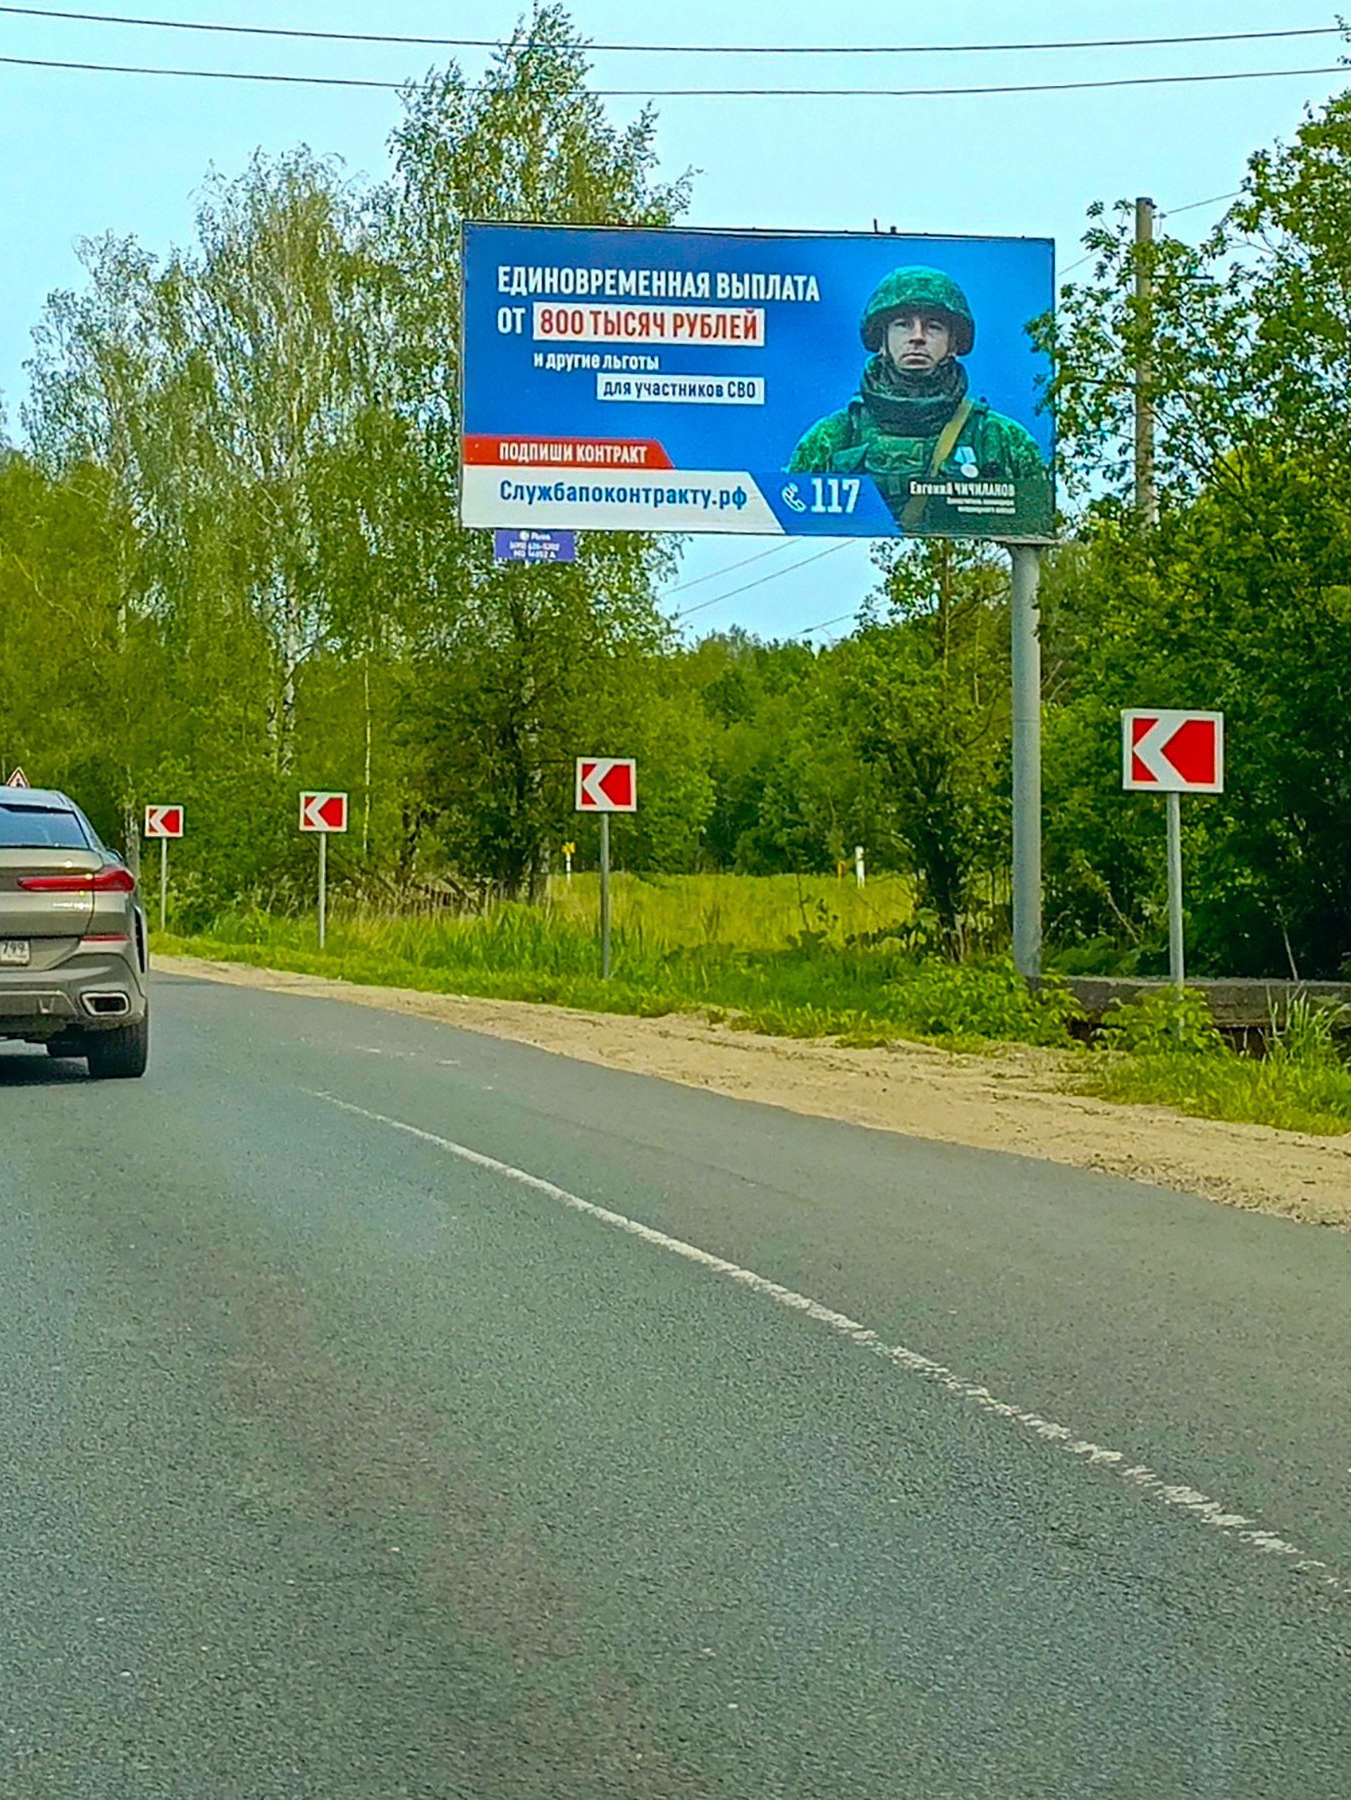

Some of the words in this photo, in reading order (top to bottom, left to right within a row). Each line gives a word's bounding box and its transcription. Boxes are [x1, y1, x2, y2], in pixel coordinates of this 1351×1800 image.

[498, 265, 710, 298] ЕДИНОВРЕМЕННАЯ
[716, 272, 820, 301] ВЫПЛАТА
[497, 306, 525, 334] ОТ
[541, 308, 584, 335] 800
[589, 310, 665, 337] ТЫСЯЧ
[672, 307, 757, 340] РУБЛЕЙ
[534, 352, 543, 367] и
[546, 352, 600, 371] другие
[602, 354, 660, 370] льготы
[603, 381, 631, 396] для
[636, 381, 724, 399] участников
[727, 381, 756, 398] СВО
[499, 442, 573, 463] ПОДПИШИ
[576, 443, 647, 464] КОНТРАКТ
[499, 479, 748, 511] Службапоконтракту.рф
[811, 477, 861, 514] 117
